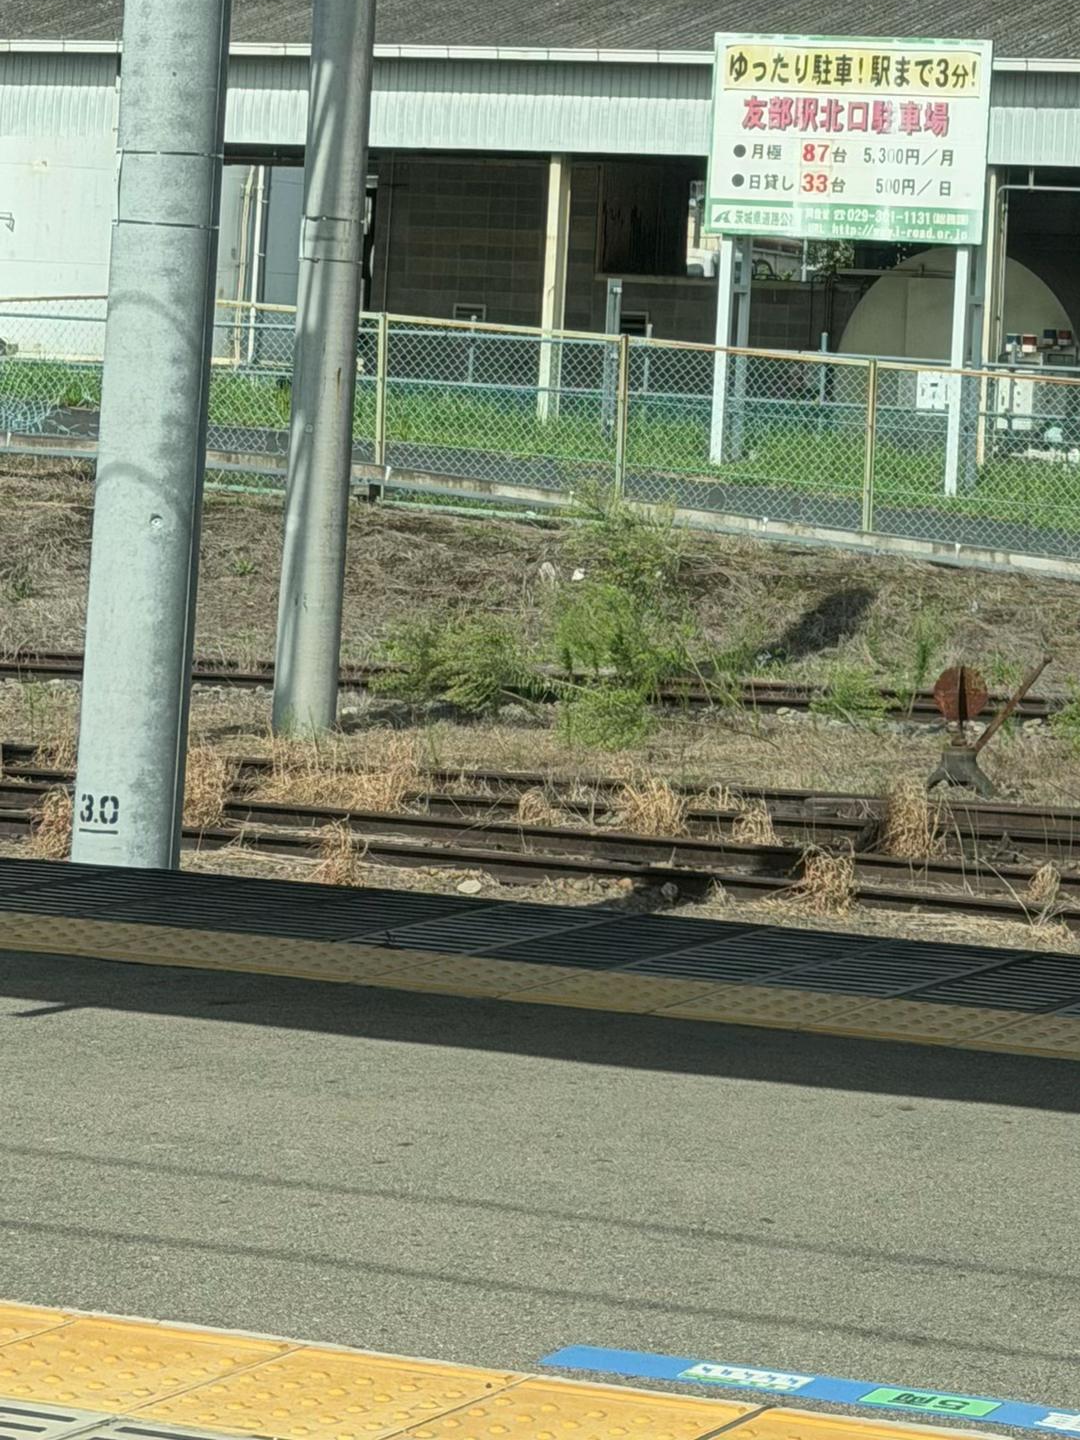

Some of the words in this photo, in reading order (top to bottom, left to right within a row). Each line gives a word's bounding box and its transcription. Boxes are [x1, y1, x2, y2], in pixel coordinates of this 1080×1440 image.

[741, 95, 952, 138] 友部駅北口駐車場
[750, 143, 782, 161] 月極
[748, 173, 795, 192] 日貸し
[80, 793, 119, 825] 3.0
